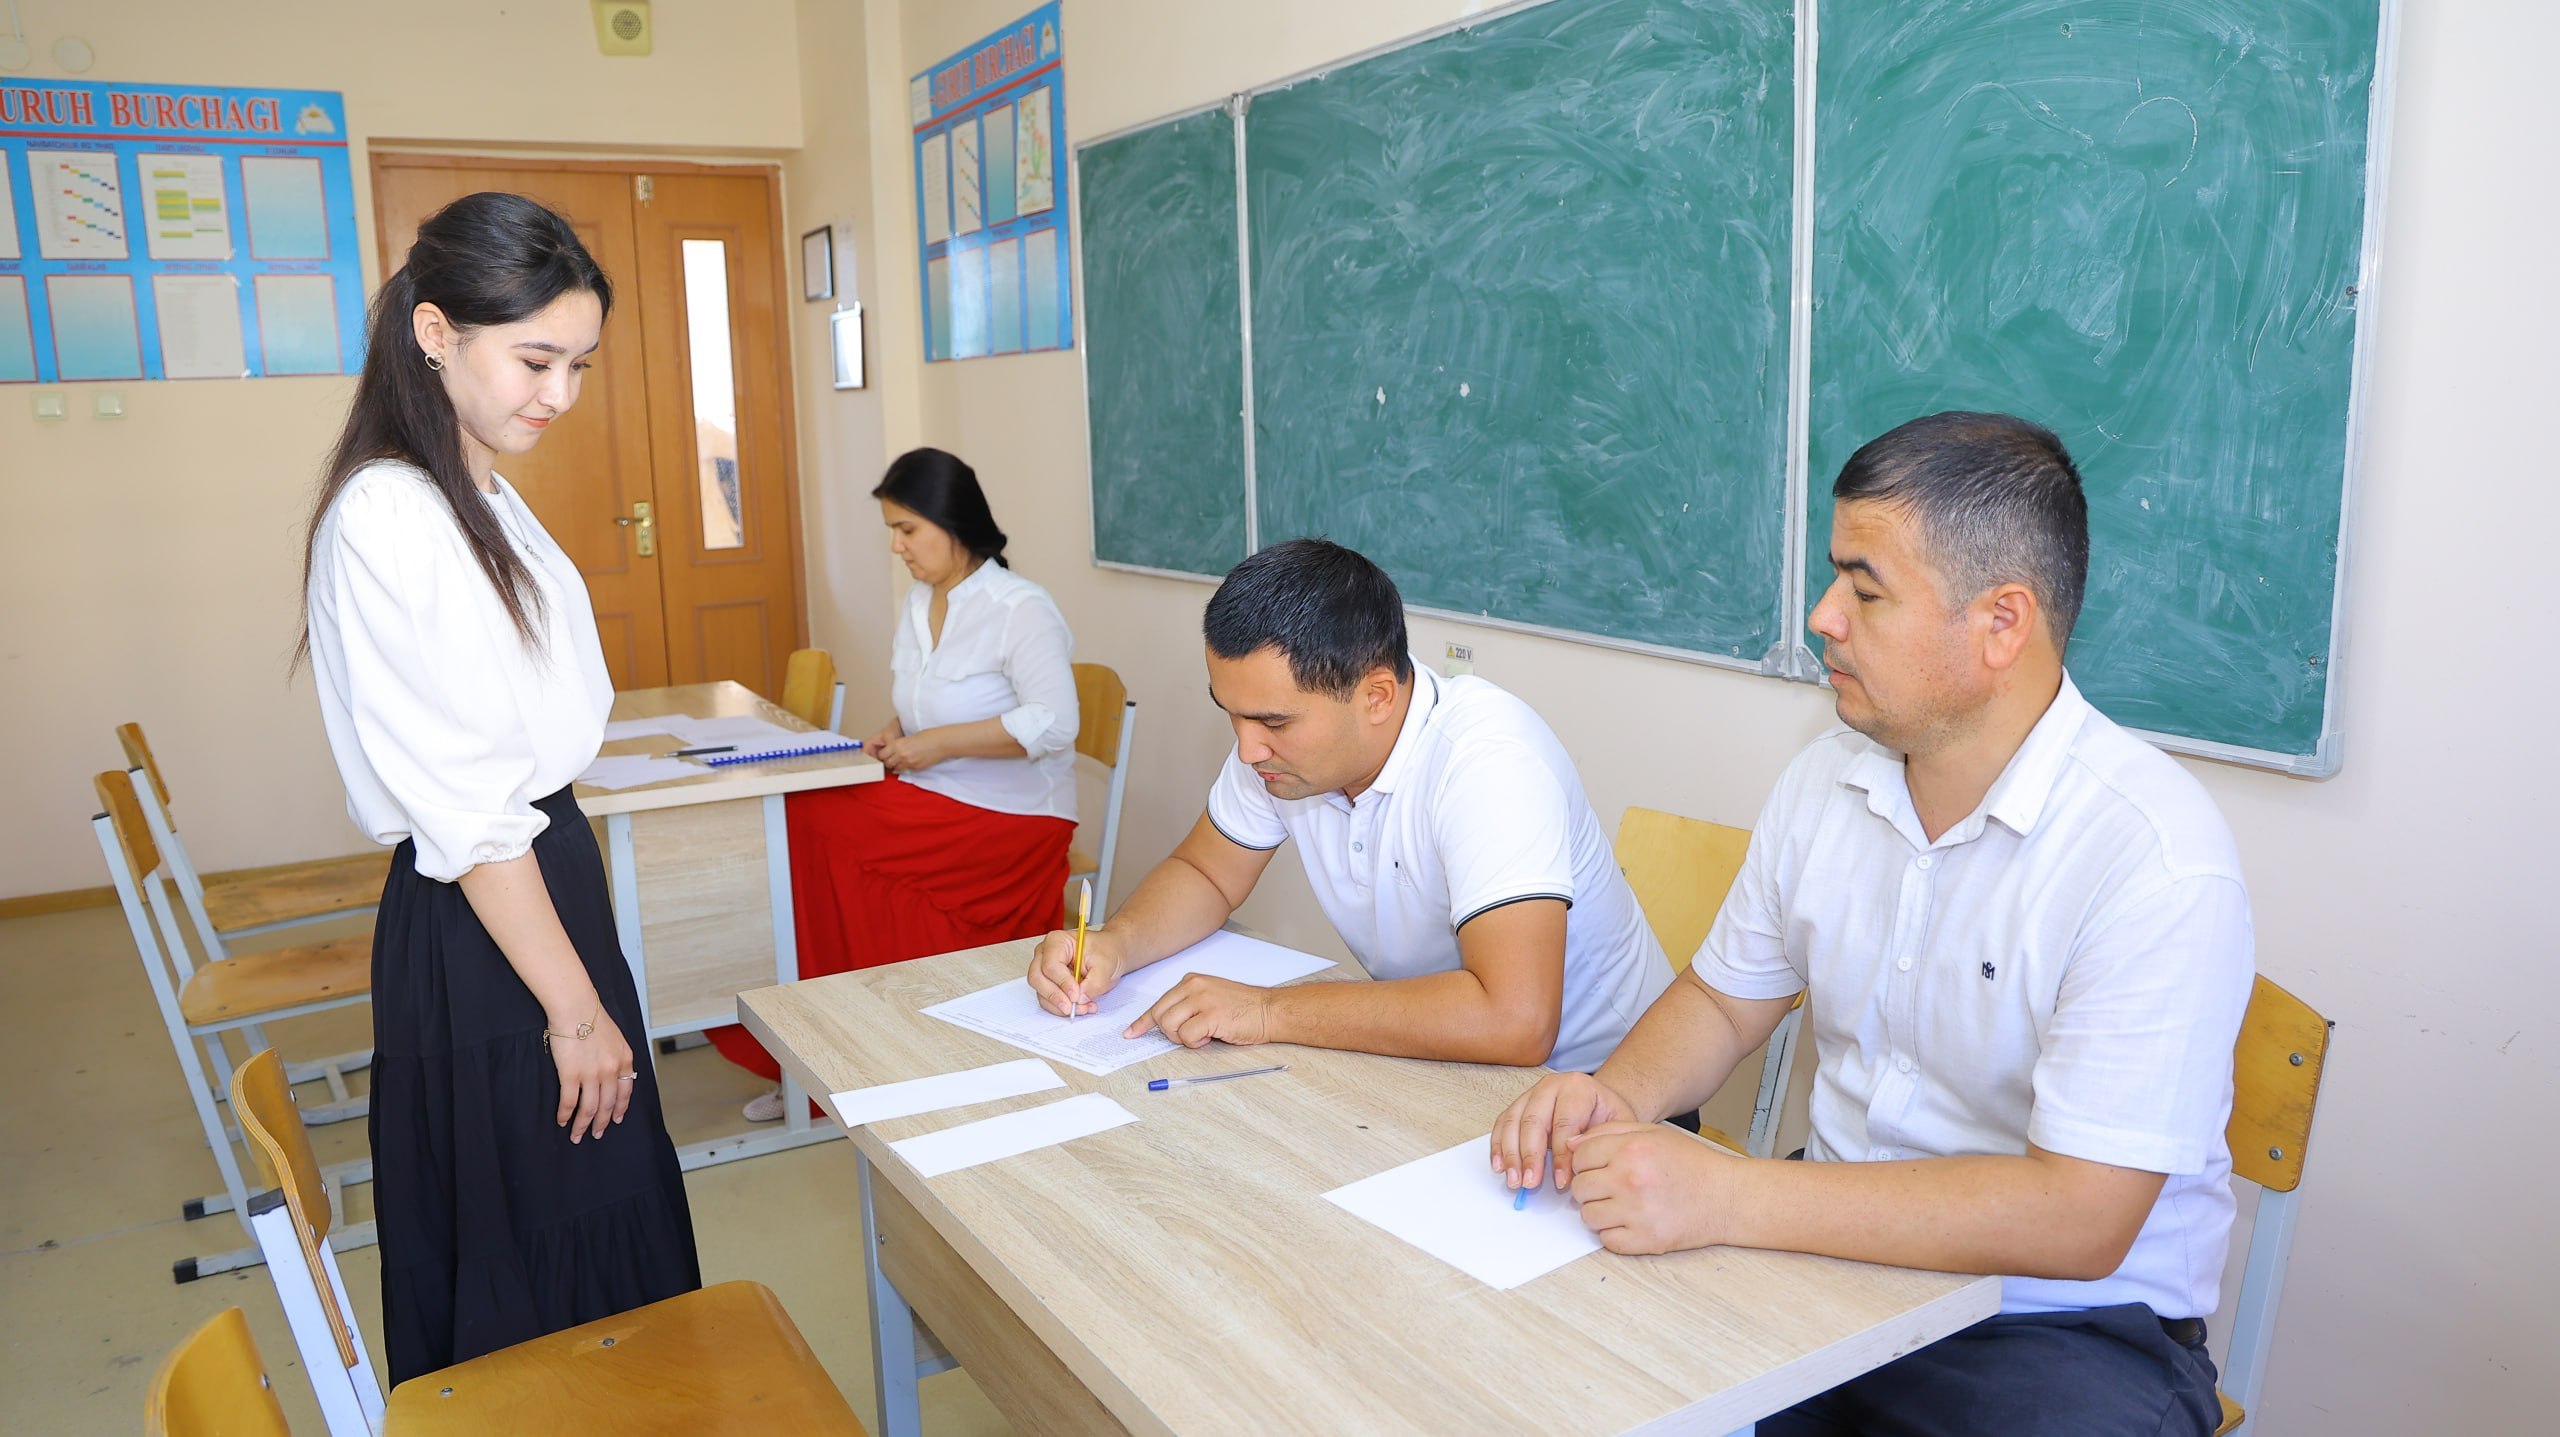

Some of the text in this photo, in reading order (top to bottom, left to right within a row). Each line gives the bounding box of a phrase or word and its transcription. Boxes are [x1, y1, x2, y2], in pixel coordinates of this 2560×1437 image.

[109, 93, 281, 132] BURCHAGI
[1455, 647, 1472, 660] 220 V
